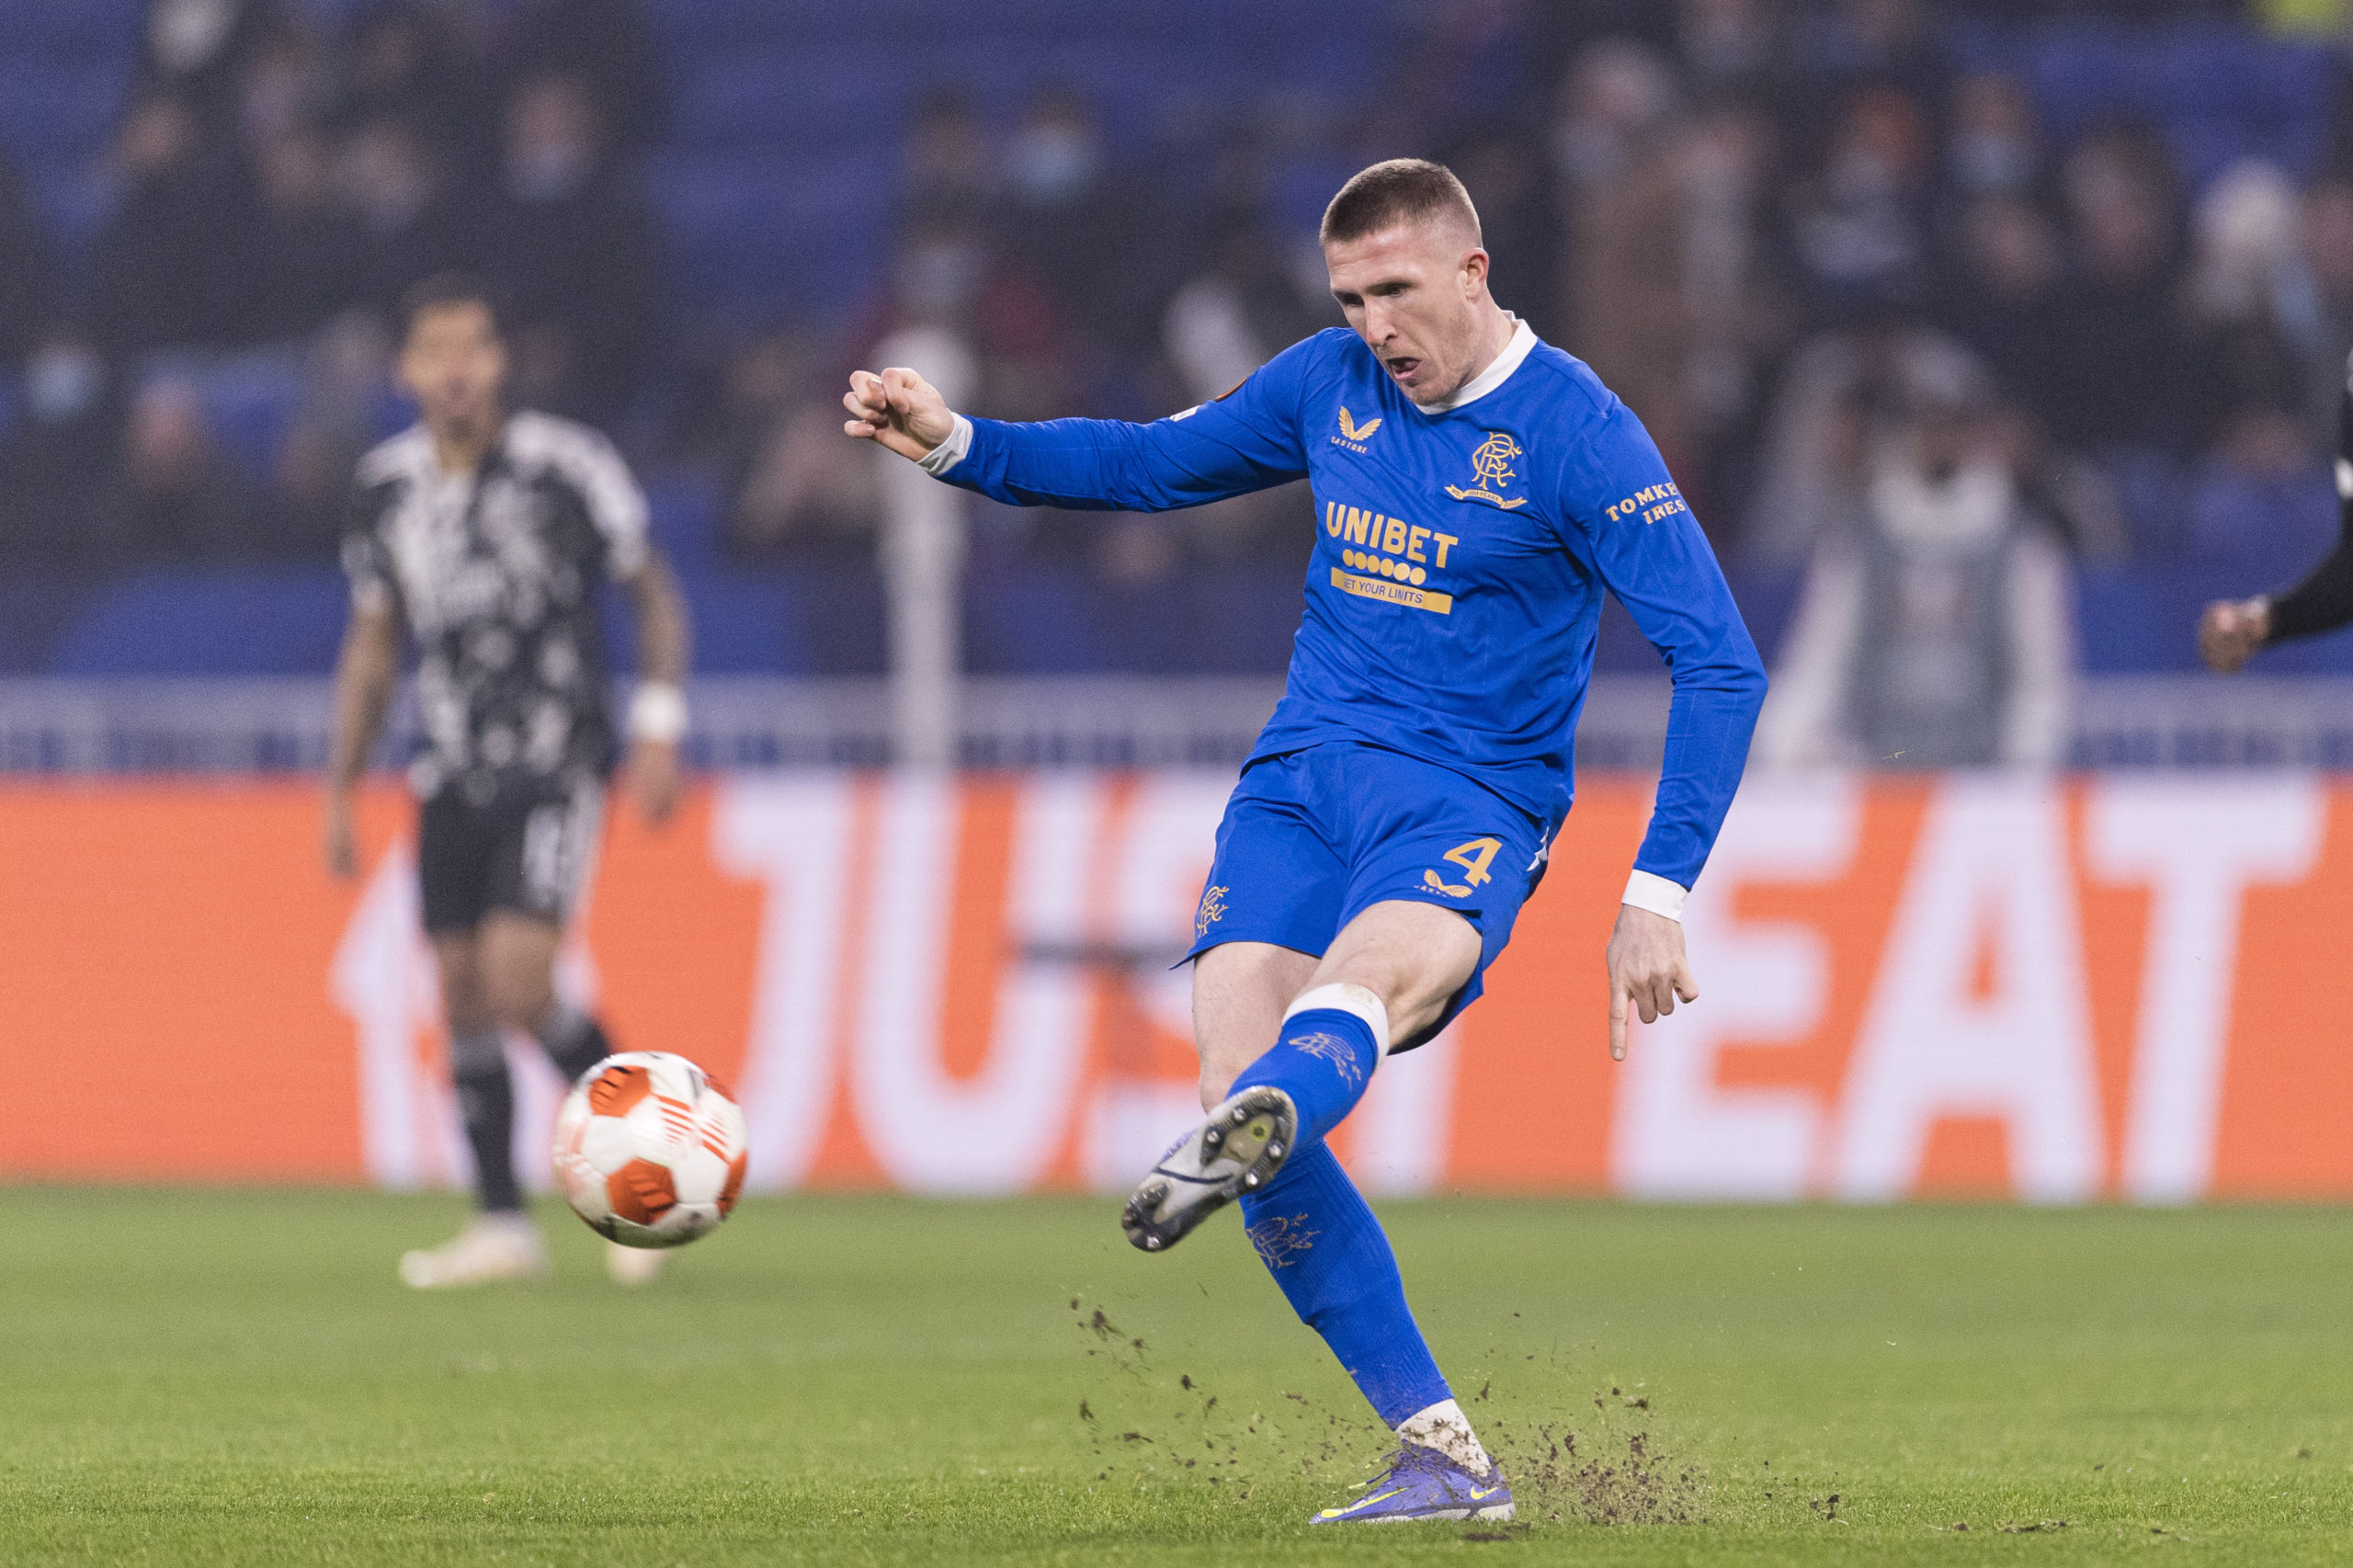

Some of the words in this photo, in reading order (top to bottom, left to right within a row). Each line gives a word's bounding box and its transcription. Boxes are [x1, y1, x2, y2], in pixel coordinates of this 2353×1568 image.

[1326, 501, 1459, 569] UNIBET
[1344, 577, 1357, 590] ET
[1358, 580, 1386, 596] YOUR
[1442, 836, 1503, 888] 4
[708, 772, 1463, 1192] JUS
[1610, 772, 2327, 1204] EAT
